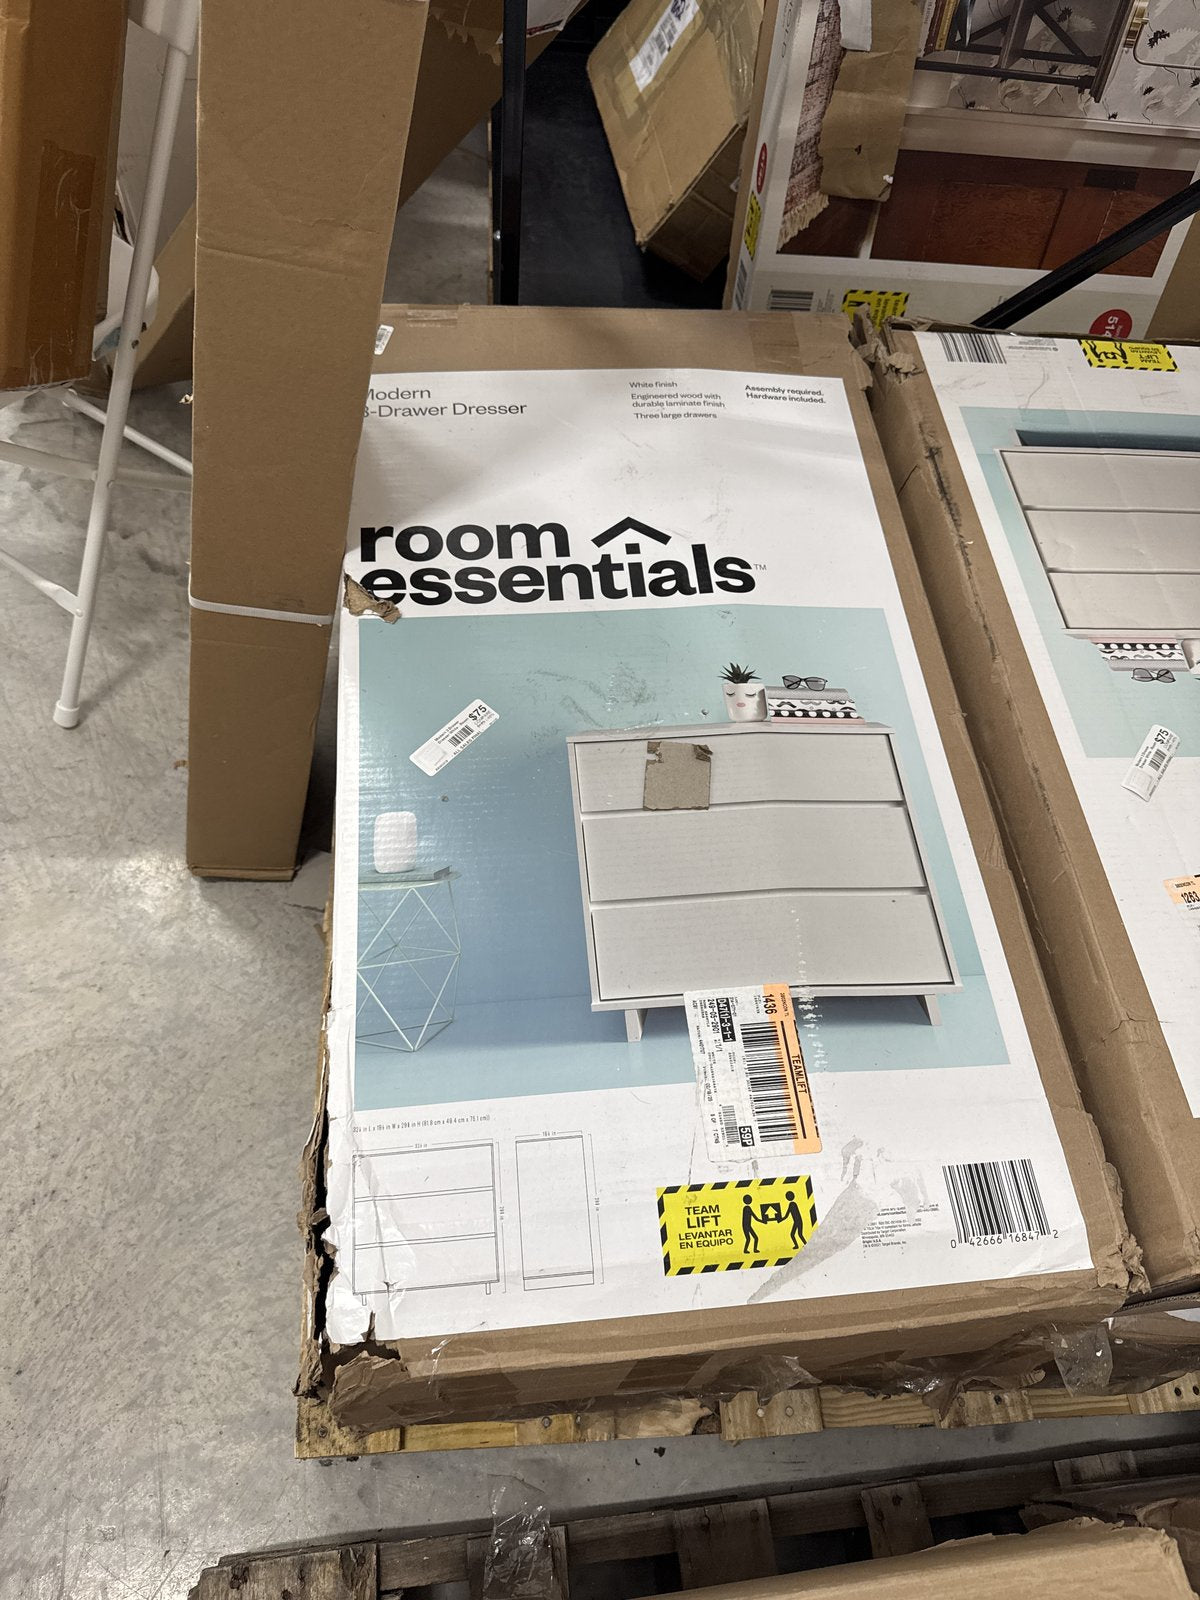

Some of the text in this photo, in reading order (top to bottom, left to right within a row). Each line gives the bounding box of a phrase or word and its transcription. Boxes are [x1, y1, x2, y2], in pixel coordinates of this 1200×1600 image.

[631, 392, 678, 400] Engineered
[744, 384, 824, 396] Assembly required.
[746, 392, 826, 404] Hardware included.
[452, 402, 528, 416] Dresser
[660, 412, 682, 420] large
[360, 522, 570, 562] room
[360, 542, 756, 606] essentials
[468, 704, 487, 721] $75
[1154, 728, 1169, 744] $75
[1180, 892, 1200, 905] 1263
[762, 993, 778, 1015] 1436
[717, 998, 734, 1042] D47(1)-3-1-1
[791, 1054, 808, 1094] TEAMLIFT
[740, 1127, 753, 1146] 59P
[685, 1204, 720, 1216] TEAM
[686, 1215, 722, 1229] LIFT
[678, 1229, 733, 1241] LEVANTAR
[951, 1229, 1060, 1249] 0 42666 16847 2
[679, 1238, 734, 1250] EN EQUIPO
